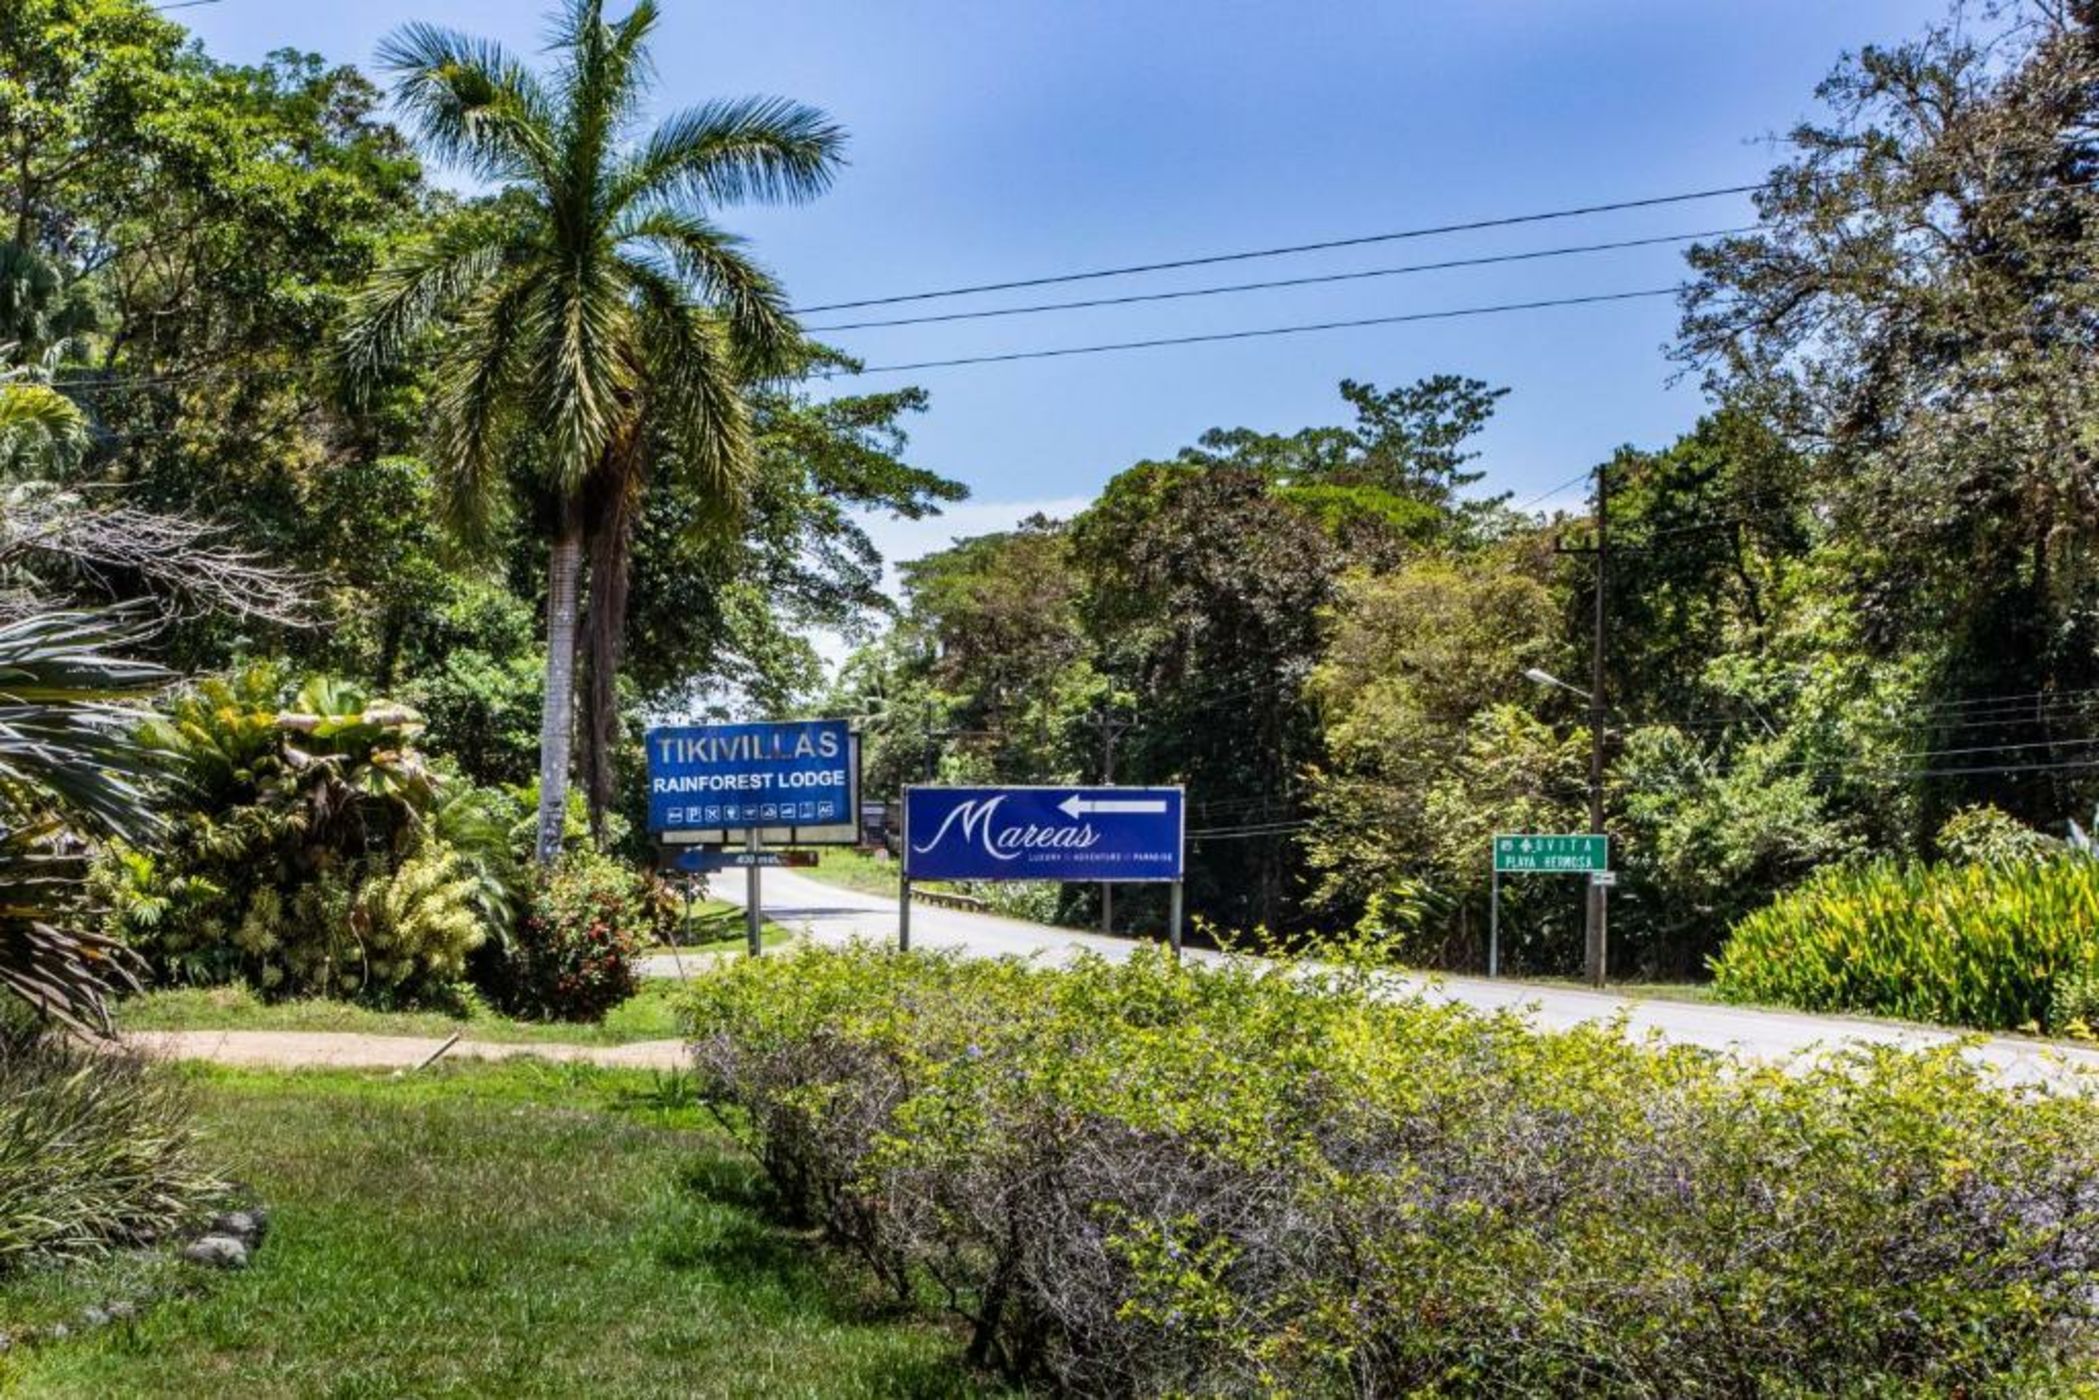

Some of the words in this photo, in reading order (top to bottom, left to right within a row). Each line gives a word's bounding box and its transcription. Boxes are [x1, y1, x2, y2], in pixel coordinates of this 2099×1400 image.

[656, 731, 839, 764] TIKIVILLAS
[653, 773, 773, 793] RAINFOREST
[778, 770, 846, 789] LODGE
[912, 795, 1101, 860] Mareas
[1133, 853, 1174, 862] PARADISE
[1505, 855, 1537, 869] PLAYA
[1544, 855, 1593, 869] HERMOSA
